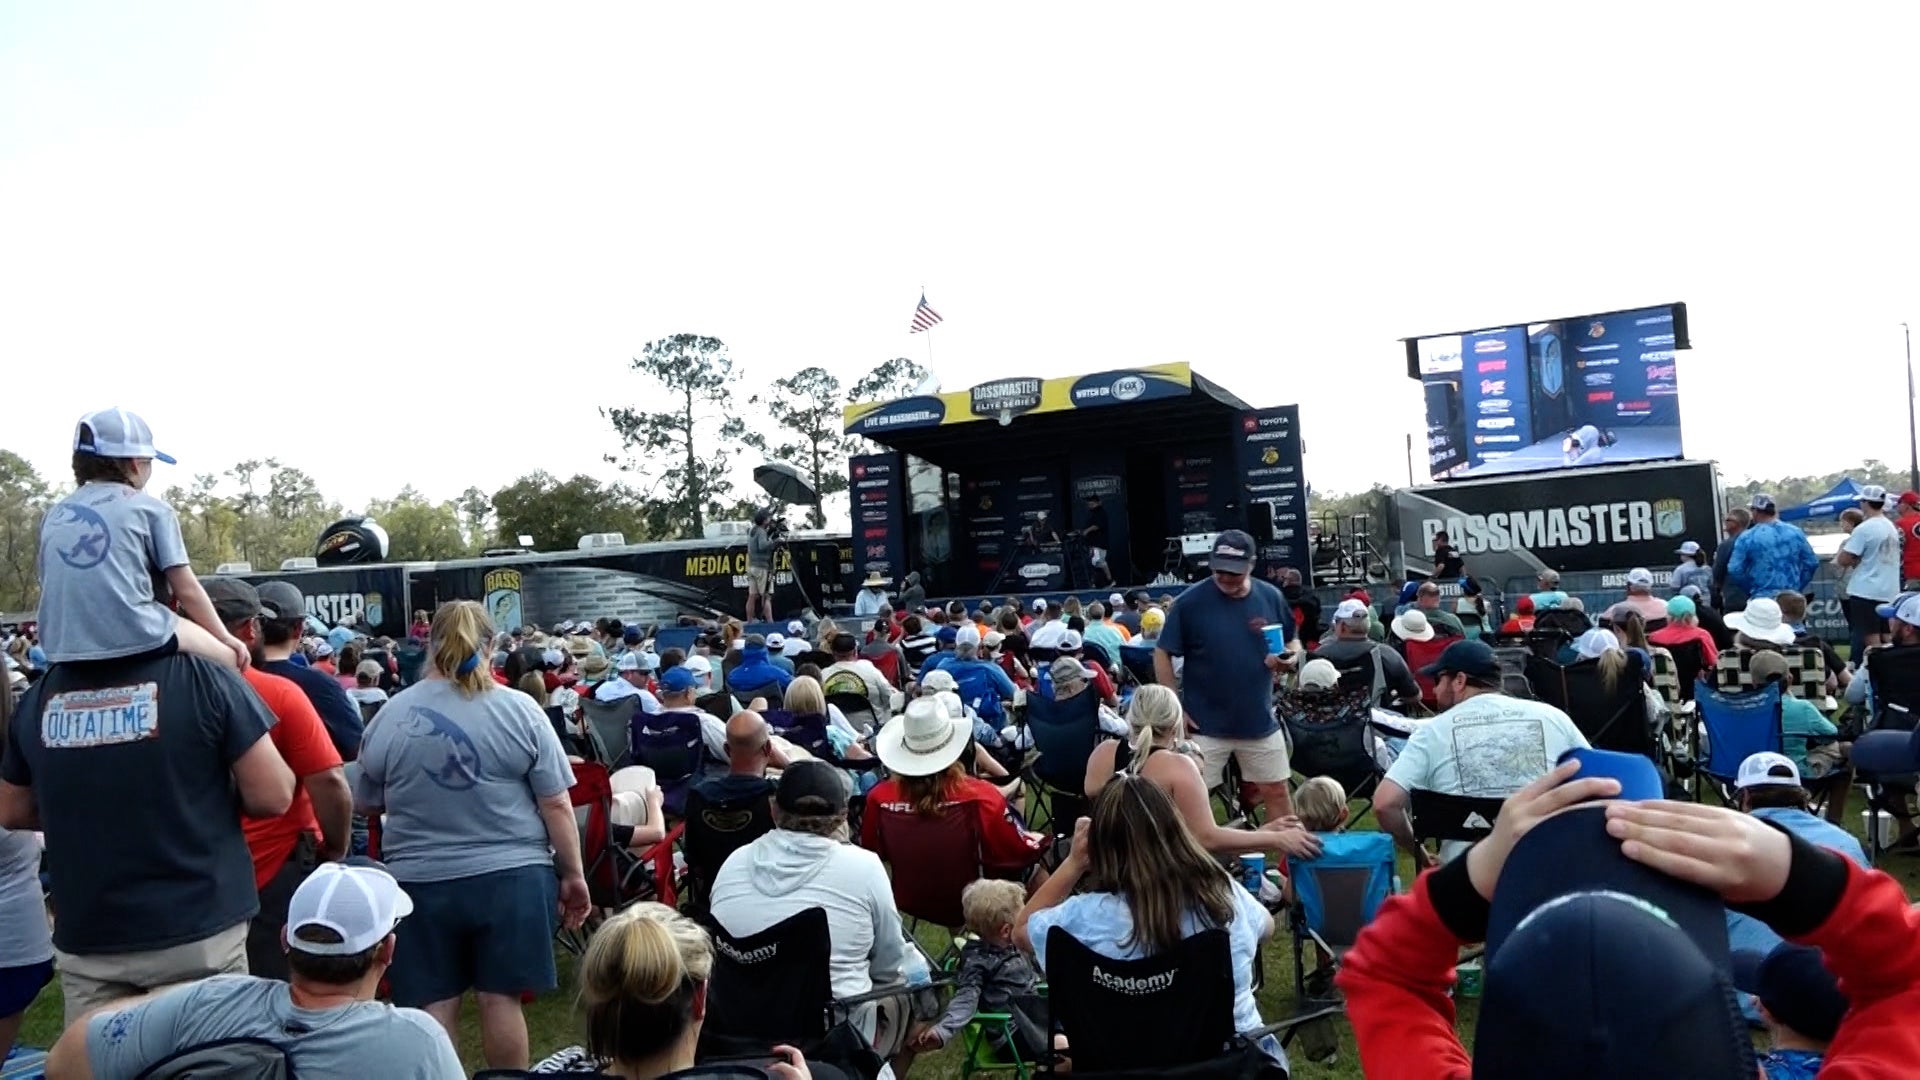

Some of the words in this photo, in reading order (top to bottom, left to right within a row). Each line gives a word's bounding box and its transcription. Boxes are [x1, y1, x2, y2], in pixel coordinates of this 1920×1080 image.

[973, 380, 1039, 400] BASSMASTER
[1259, 417, 1289, 426] TOYOTA
[1422, 500, 1655, 557] BASSMASTER
[685, 553, 731, 577] MEDIA
[47, 702, 150, 740] OUTATIME
[1092, 965, 1176, 992] Academy
